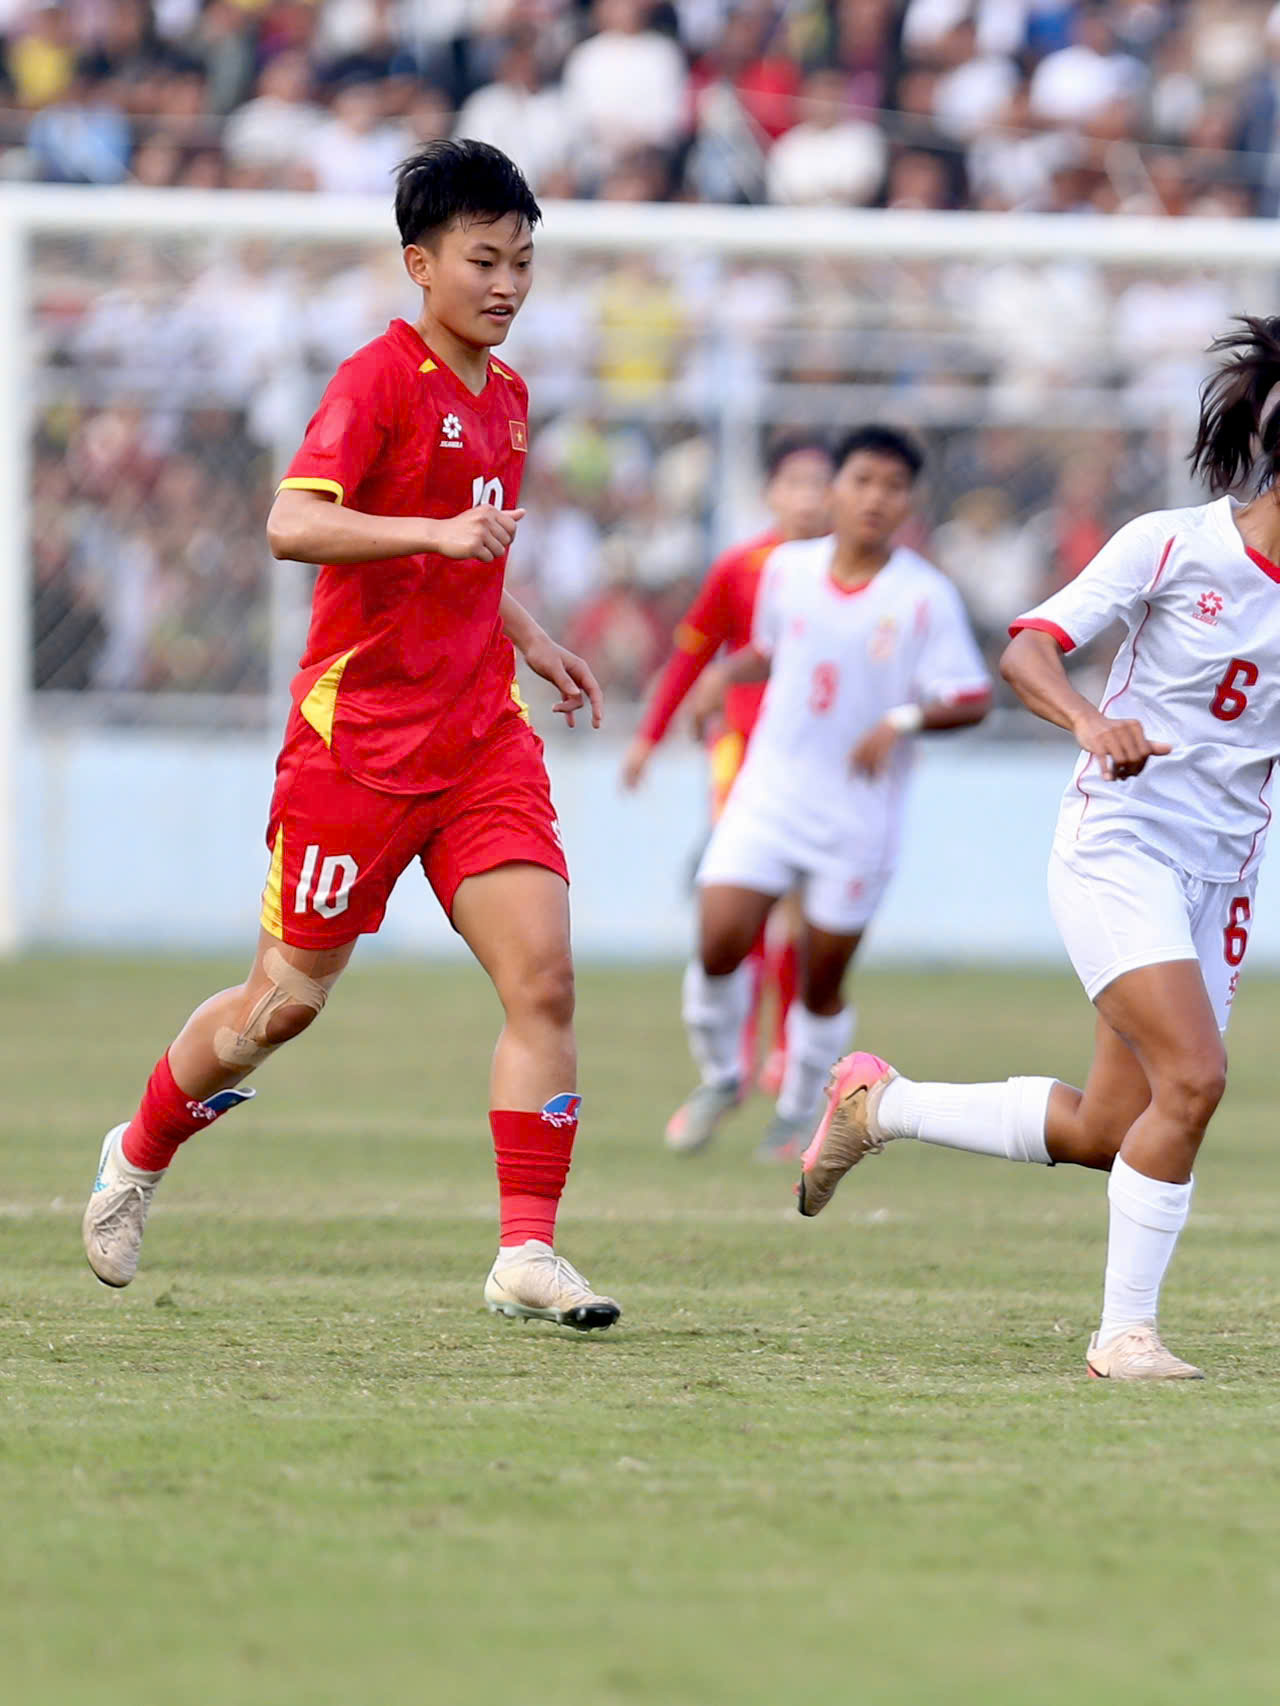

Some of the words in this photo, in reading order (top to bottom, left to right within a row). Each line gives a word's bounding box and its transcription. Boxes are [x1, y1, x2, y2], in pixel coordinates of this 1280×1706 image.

[1208, 657, 1259, 722] 6
[294, 844, 359, 919] 10
[1223, 896, 1251, 967] 6
